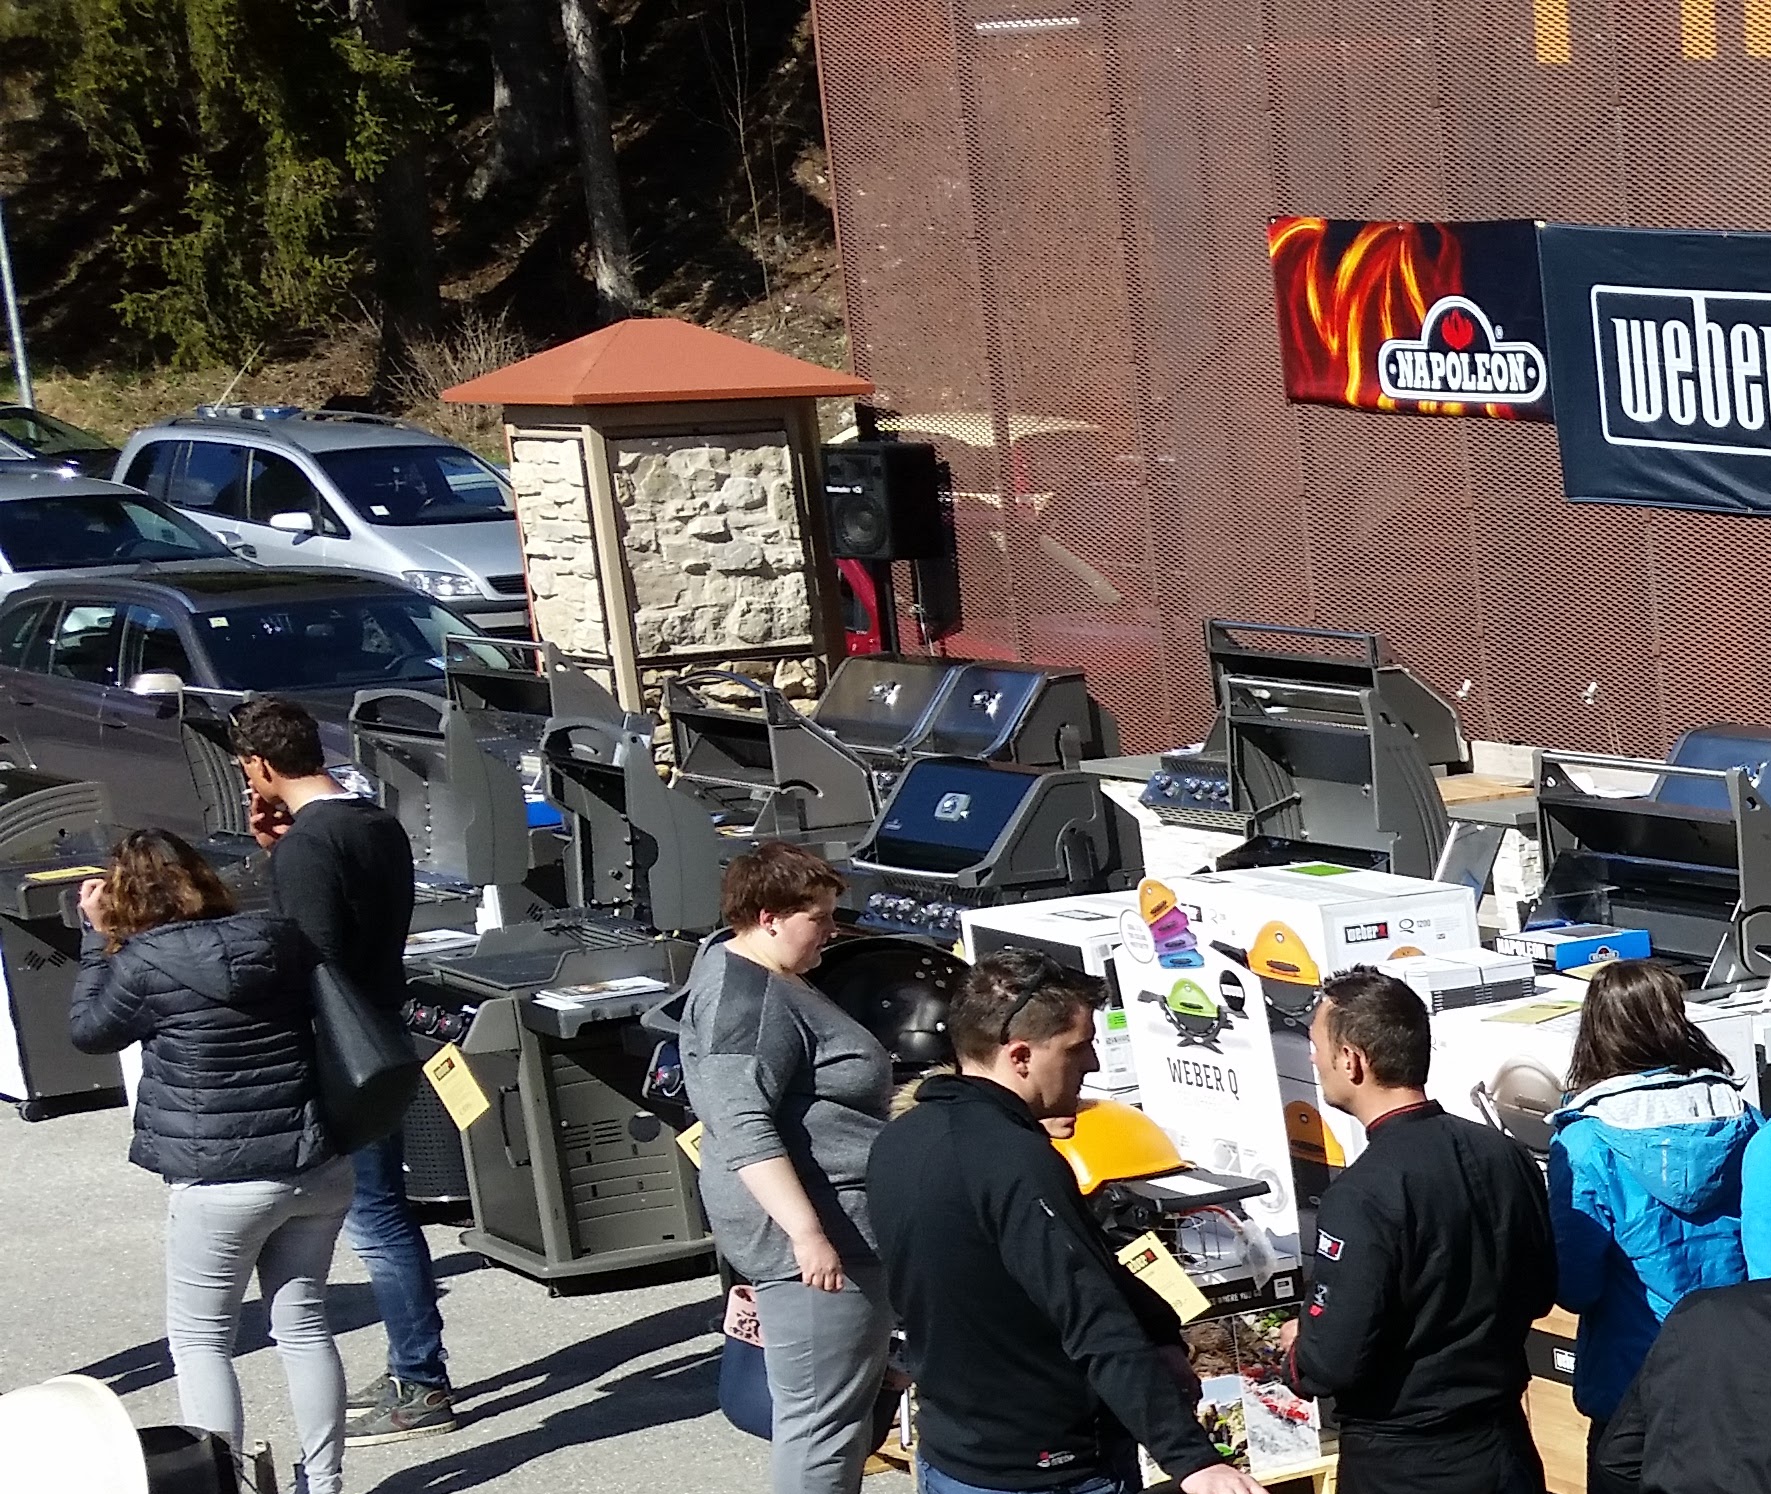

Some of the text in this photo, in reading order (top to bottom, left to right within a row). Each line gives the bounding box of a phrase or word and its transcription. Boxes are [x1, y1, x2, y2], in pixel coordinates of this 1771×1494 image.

[1397, 351, 1528, 391] NAPOLEON
[1166, 1057, 1240, 1101] WEBER Q
